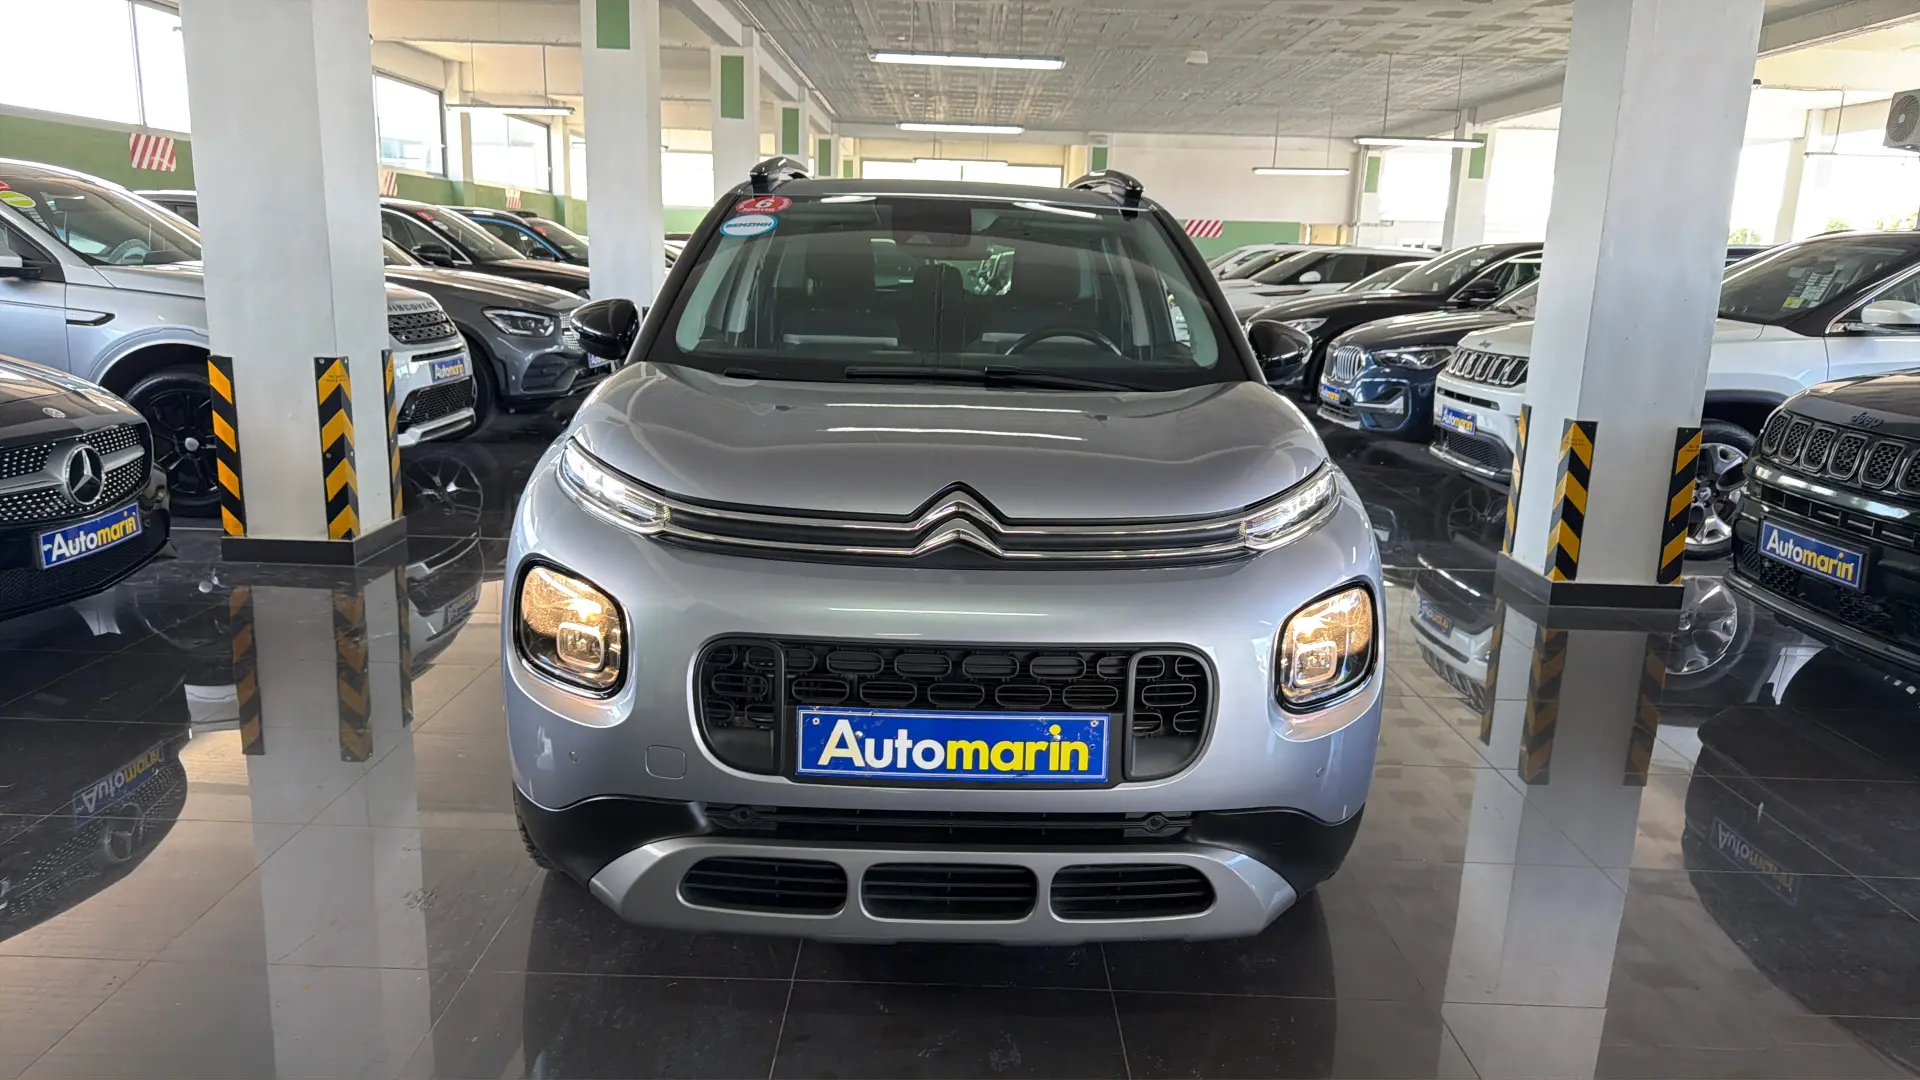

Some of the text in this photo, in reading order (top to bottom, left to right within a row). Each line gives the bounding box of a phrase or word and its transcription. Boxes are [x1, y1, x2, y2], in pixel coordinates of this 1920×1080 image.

[434, 359, 465, 380] Automarin
[1442, 408, 1473, 432] Automarin
[51, 510, 137, 562] Automarin
[1766, 528, 1853, 581] Automarin
[817, 719, 1089, 771] Automarin
